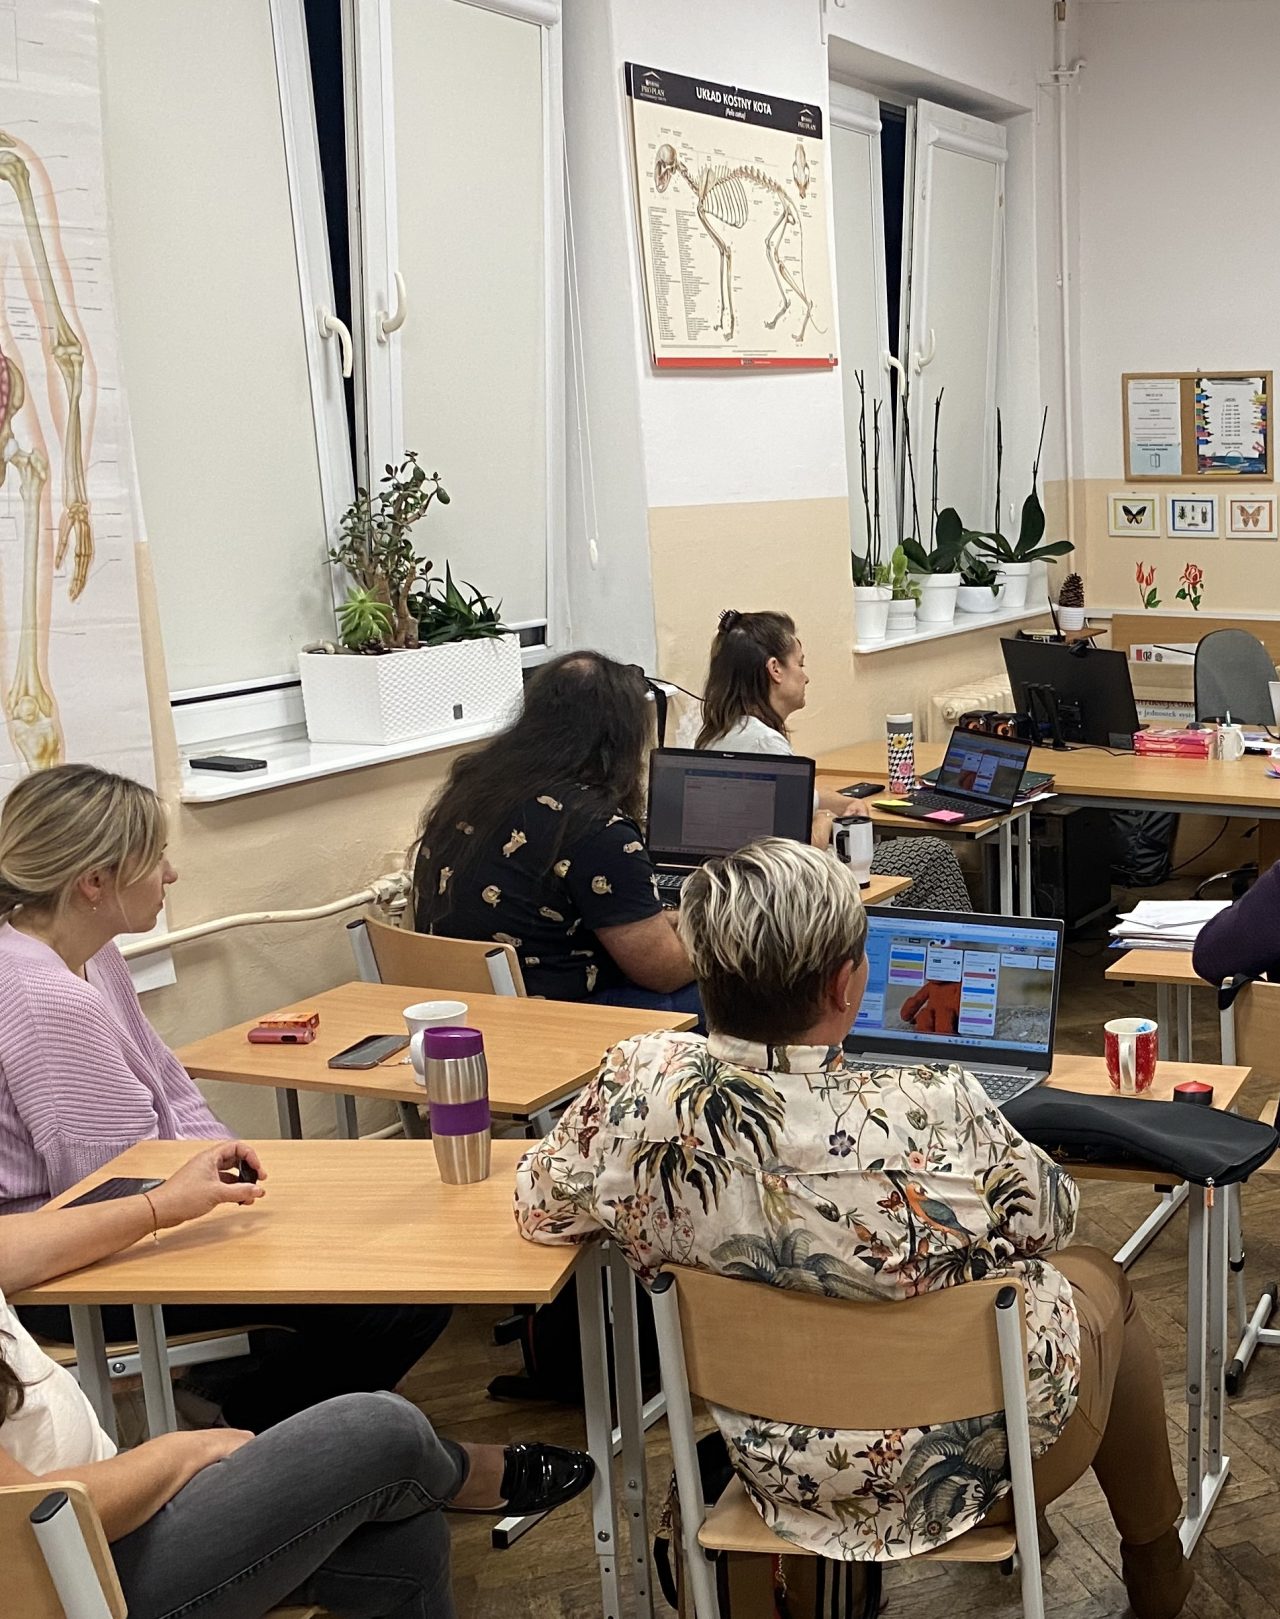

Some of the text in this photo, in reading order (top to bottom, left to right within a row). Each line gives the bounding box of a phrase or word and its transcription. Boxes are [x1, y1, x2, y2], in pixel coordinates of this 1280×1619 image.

[695, 86, 772, 115] UKŁAD KOSTNY KOTA
